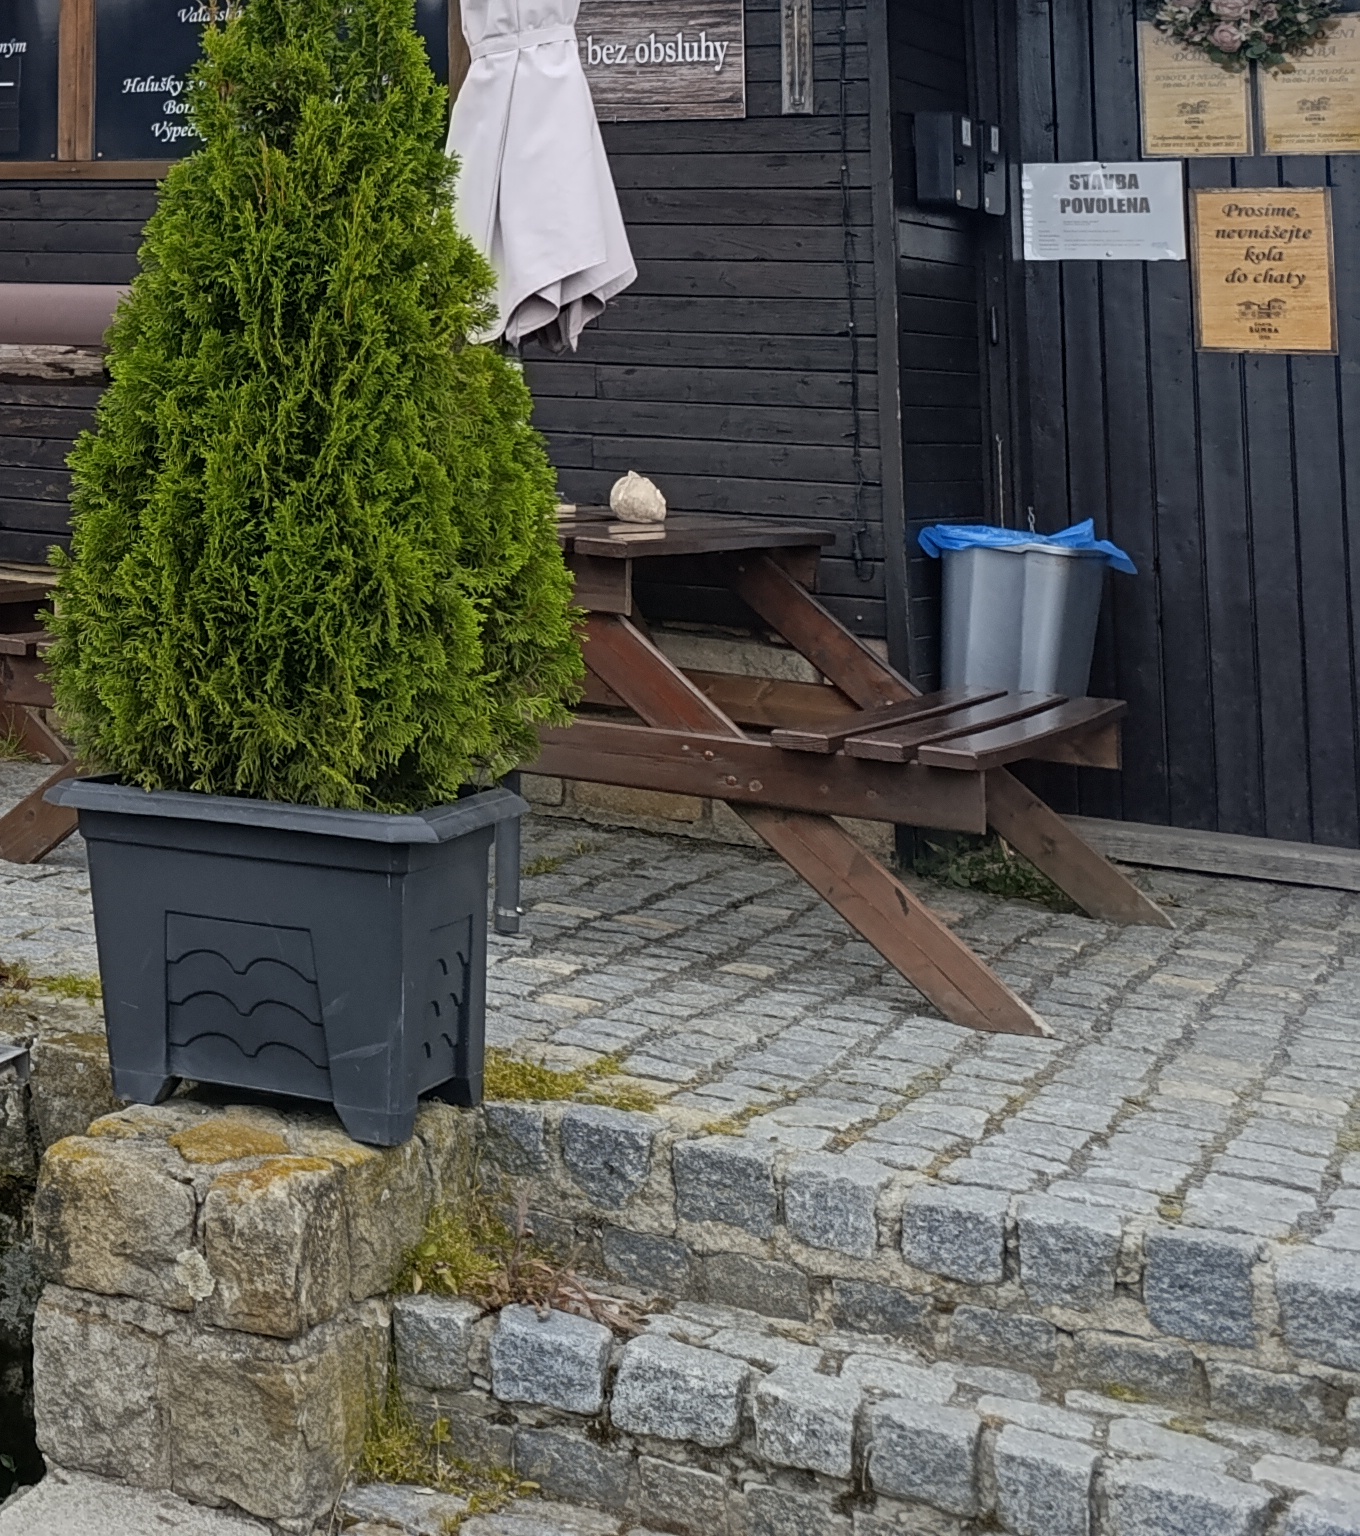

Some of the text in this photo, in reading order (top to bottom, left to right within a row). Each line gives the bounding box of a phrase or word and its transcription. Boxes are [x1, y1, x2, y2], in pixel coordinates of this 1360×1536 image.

[586, 32, 729, 71] bez obsluhy
[122, 75, 183, 96] Halušky
[1069, 173, 1139, 190] STAVBA
[1060, 197, 1151, 214] POVOLENA
[1221, 203, 1300, 219] Prosíme,
[1215, 225, 1312, 244] nevnášejte
[1244, 245, 1284, 265] kola
[1225, 267, 1306, 289] do chaty
